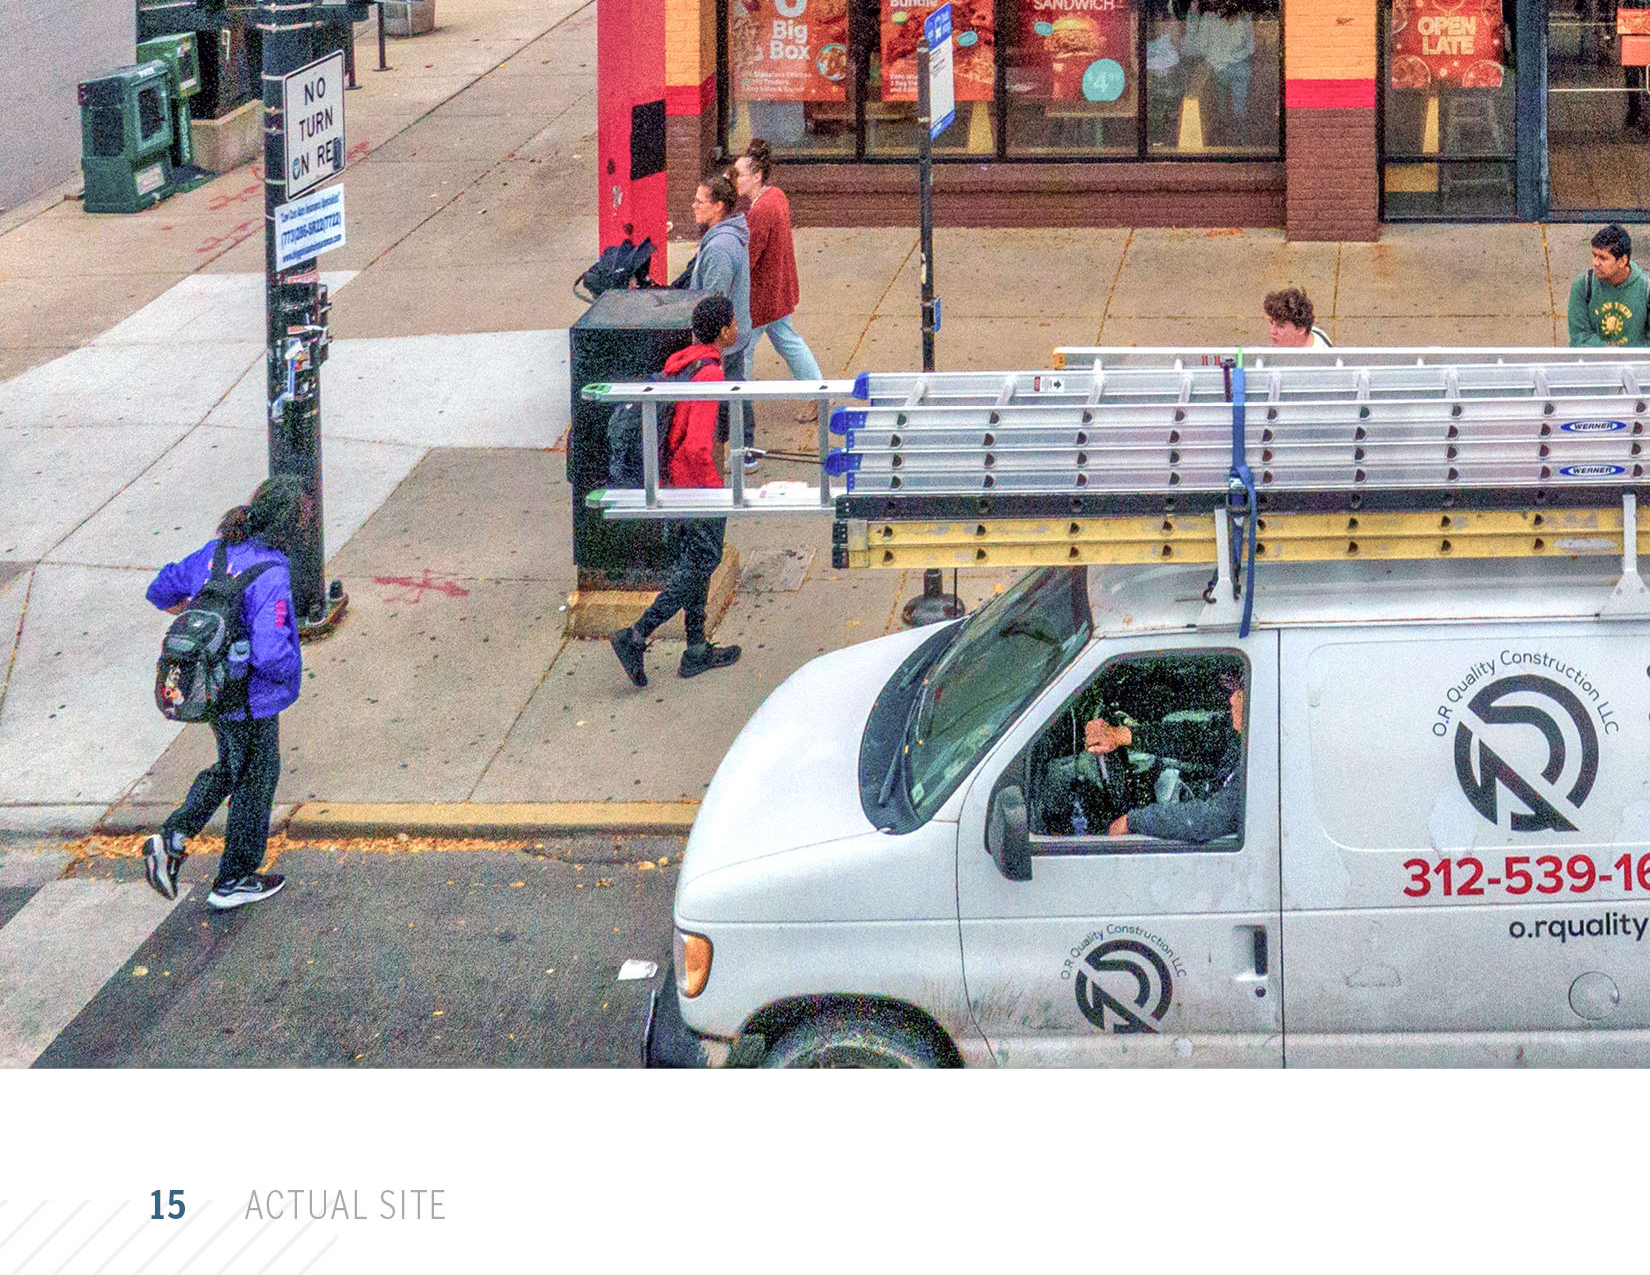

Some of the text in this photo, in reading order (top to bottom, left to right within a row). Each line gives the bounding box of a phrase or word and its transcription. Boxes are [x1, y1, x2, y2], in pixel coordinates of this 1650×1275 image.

[772, 20, 809, 45] Big
[1417, 16, 1477, 36] OPEN
[769, 39, 811, 60] Box
[1422, 36, 1475, 55] LATE
[304, 76, 326, 105] NO
[299, 106, 334, 142] TURN
[292, 152, 310, 181] ON
[1574, 422, 1613, 430] WERNER
[1432, 650, 1619, 737] O.R Quality Construction LLC
[1070, 930, 1104, 959] Quality
[1106, 923, 1174, 958] Construction
[1171, 957, 1187, 978] LLC
